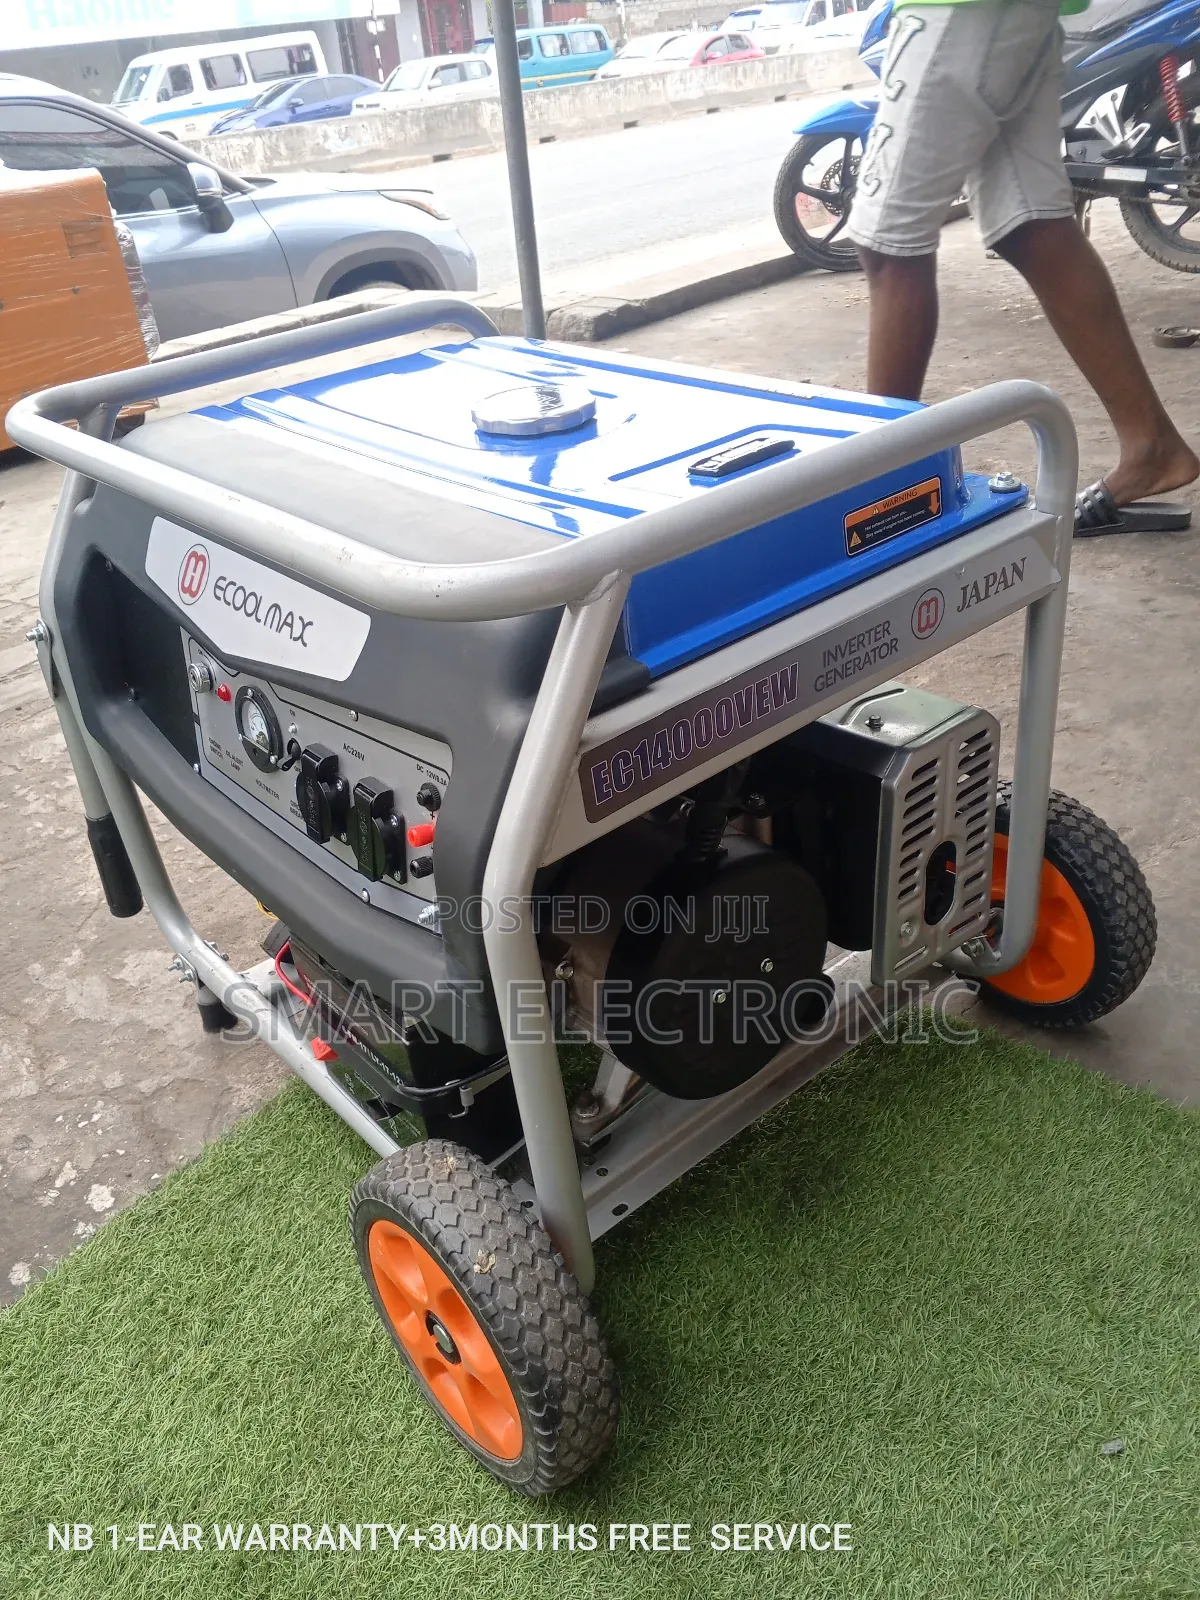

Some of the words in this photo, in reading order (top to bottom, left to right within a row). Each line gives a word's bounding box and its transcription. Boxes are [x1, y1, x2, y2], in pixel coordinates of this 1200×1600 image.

[883, 488, 918, 509] WARNING
[956, 557, 1027, 613] JAPAN
[814, 637, 899, 693] GENERATOR
[822, 620, 892, 668] INVERTER
[343, 743, 365, 761] AC220V
[591, 662, 799, 806] EC14000VEW
[416, 763, 424, 775] DC
